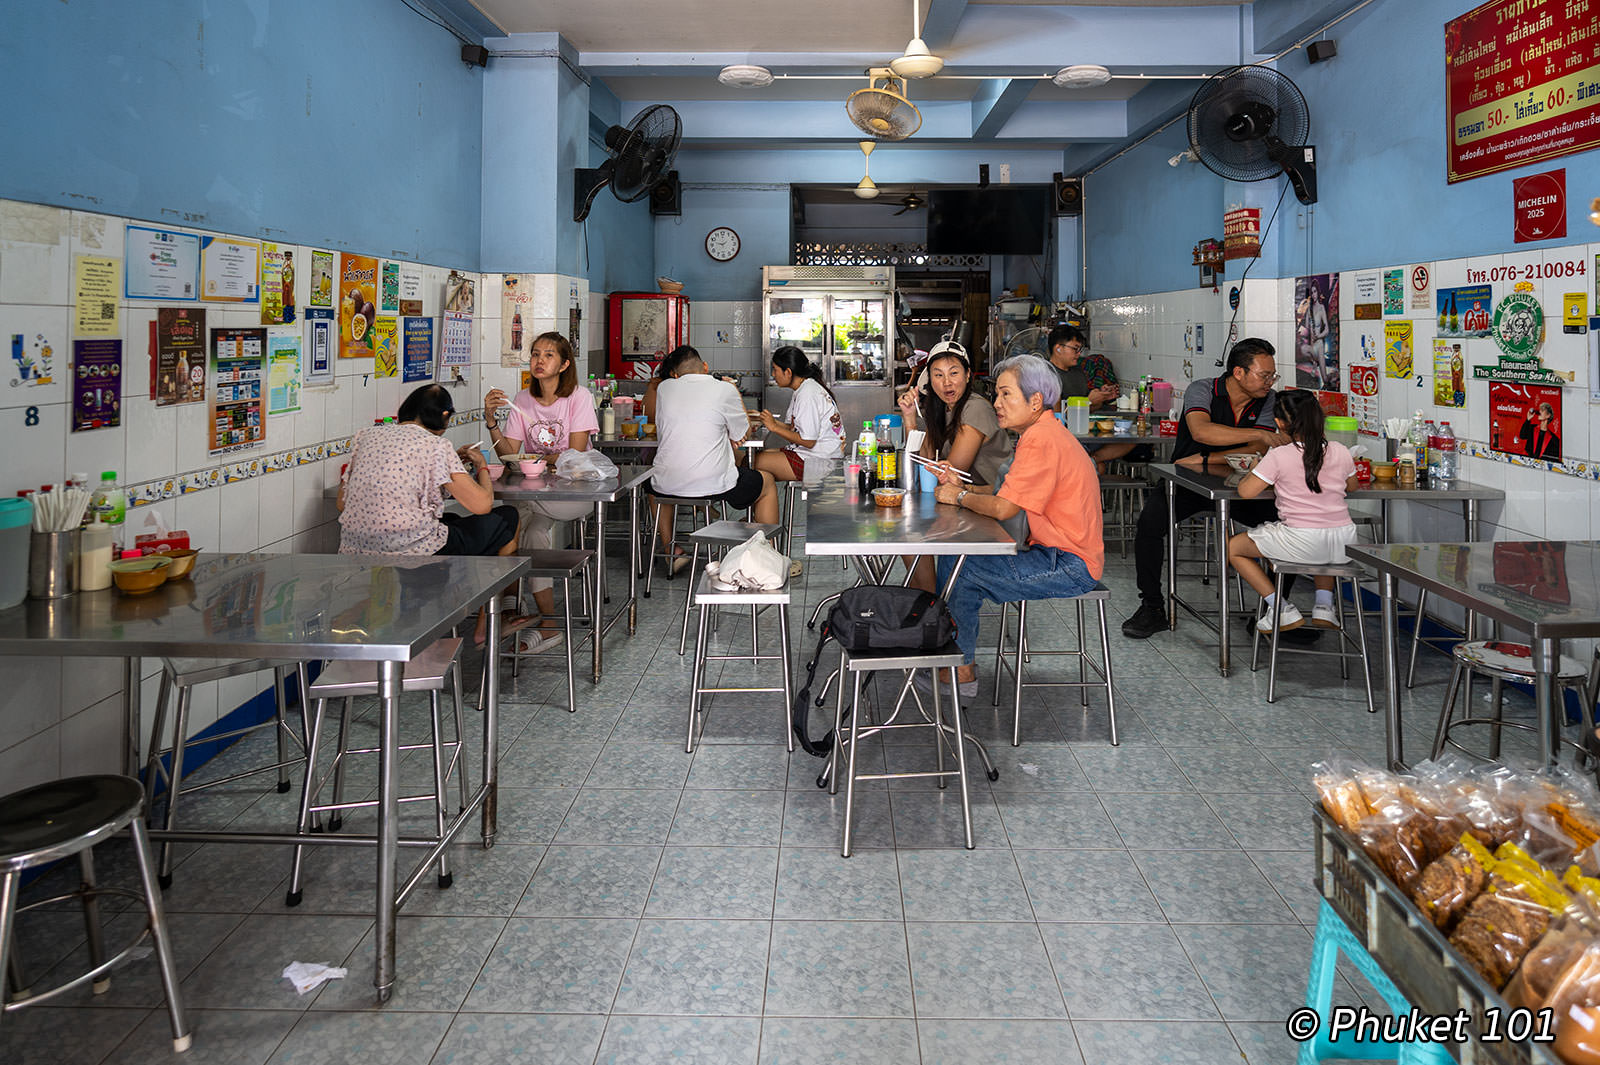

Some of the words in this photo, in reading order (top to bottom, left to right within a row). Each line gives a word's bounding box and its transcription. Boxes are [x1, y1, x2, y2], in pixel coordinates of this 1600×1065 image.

[1505, 11, 1553, 45] หมี่เส้นเล็ก
[1458, 121, 1485, 138] ธรรมดา
[1487, 108, 1510, 129] 50.-
[1547, 87, 1573, 110] 60.-
[1518, 194, 1557, 209] MICHELIN
[1527, 208, 1545, 219] 2025
[1466, 260, 1587, 284] โทร.076-210084
[1508, 294, 1540, 310] PHUKET
[362, 373, 369, 387] 7
[1416, 375, 1424, 388] 2
[1475, 368, 1490, 377] The
[1491, 368, 1526, 380] Southern
[1528, 371, 1544, 380] Sea
[24, 405, 40, 427] 8
